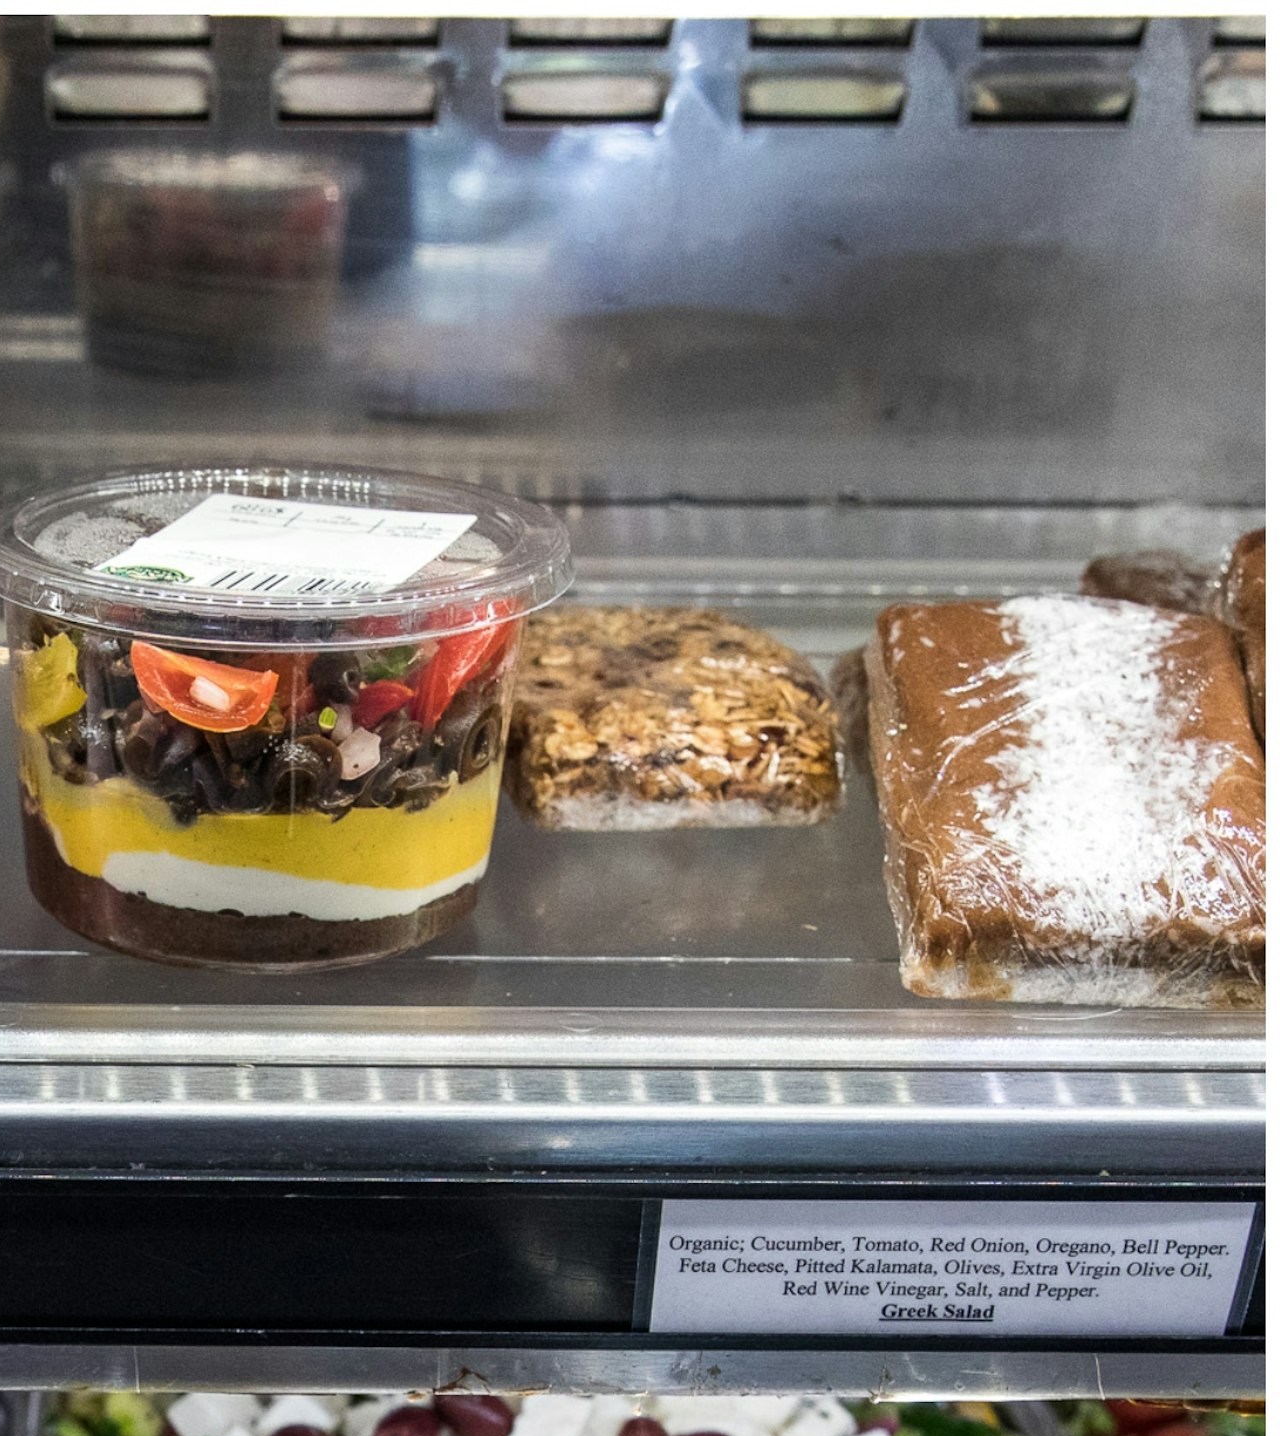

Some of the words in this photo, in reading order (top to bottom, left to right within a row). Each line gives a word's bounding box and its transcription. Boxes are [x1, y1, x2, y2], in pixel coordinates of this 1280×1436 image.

[669, 1235, 745, 1254] Organic;
[750, 1236, 846, 1254] Cucumber,
[851, 1236, 924, 1254] Tomato,
[930, 1237, 966, 1253] Red
[970, 1237, 1030, 1255] Onion,
[1035, 1237, 1116, 1258] Oregano,
[1122, 1239, 1160, 1255] Bell
[1164, 1239, 1230, 1260] Pepper.
[678, 1257, 717, 1274] Feta
[721, 1257, 789, 1276] Cheese,
[794, 1258, 846, 1274] Pitted
[850, 1258, 938, 1277] Kalamata,
[943, 1259, 1006, 1277] Olives,
[1010, 1260, 1059, 1276] Extra
[1065, 1261, 1121, 1280] Virgin
[1125, 1261, 1176, 1278] Olive
[1179, 1261, 1213, 1280] Oil,
[781, 1280, 818, 1297] Red
[824, 1280, 870, 1297] Wine
[875, 1280, 949, 1300] Vinegar,
[954, 1281, 993, 1300] Salt,
[997, 1282, 1031, 1298] and
[1035, 1283, 1100, 1302] Pepper.
[879, 1303, 940, 1322] Greek
[942, 1304, 995, 1322] Salad
